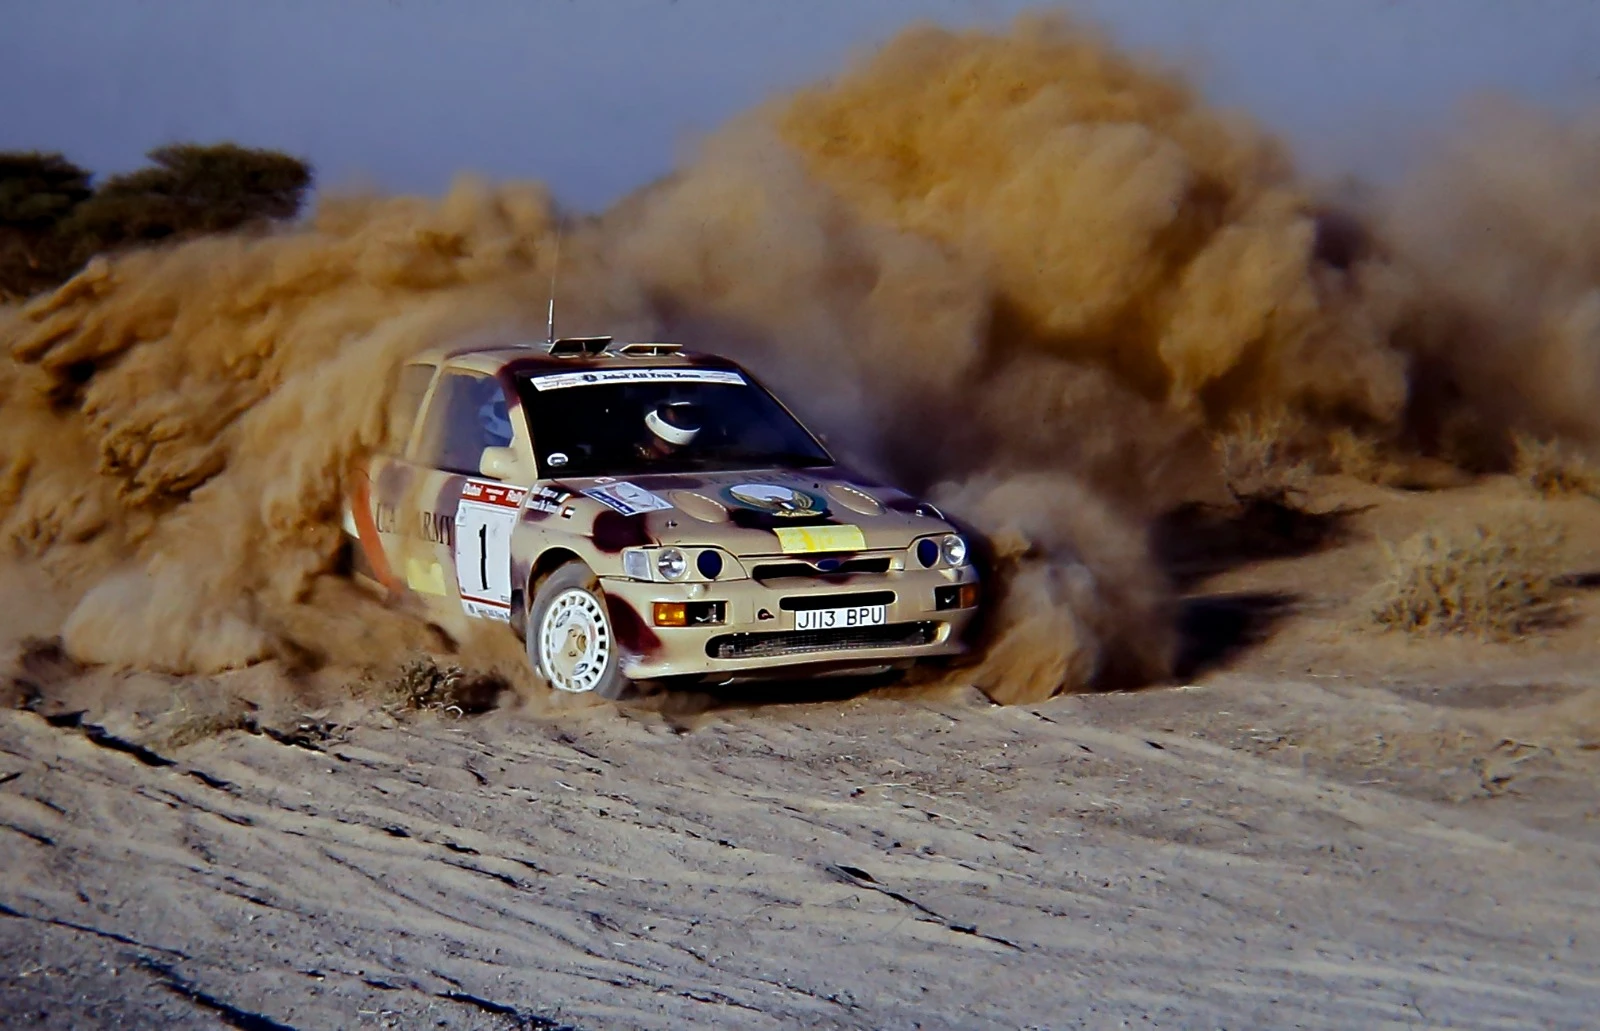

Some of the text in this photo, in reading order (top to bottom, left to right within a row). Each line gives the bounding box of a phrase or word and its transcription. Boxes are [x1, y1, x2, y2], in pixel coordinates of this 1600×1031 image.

[478, 523, 490, 591] 1
[798, 606, 882, 629] J113 BPU
